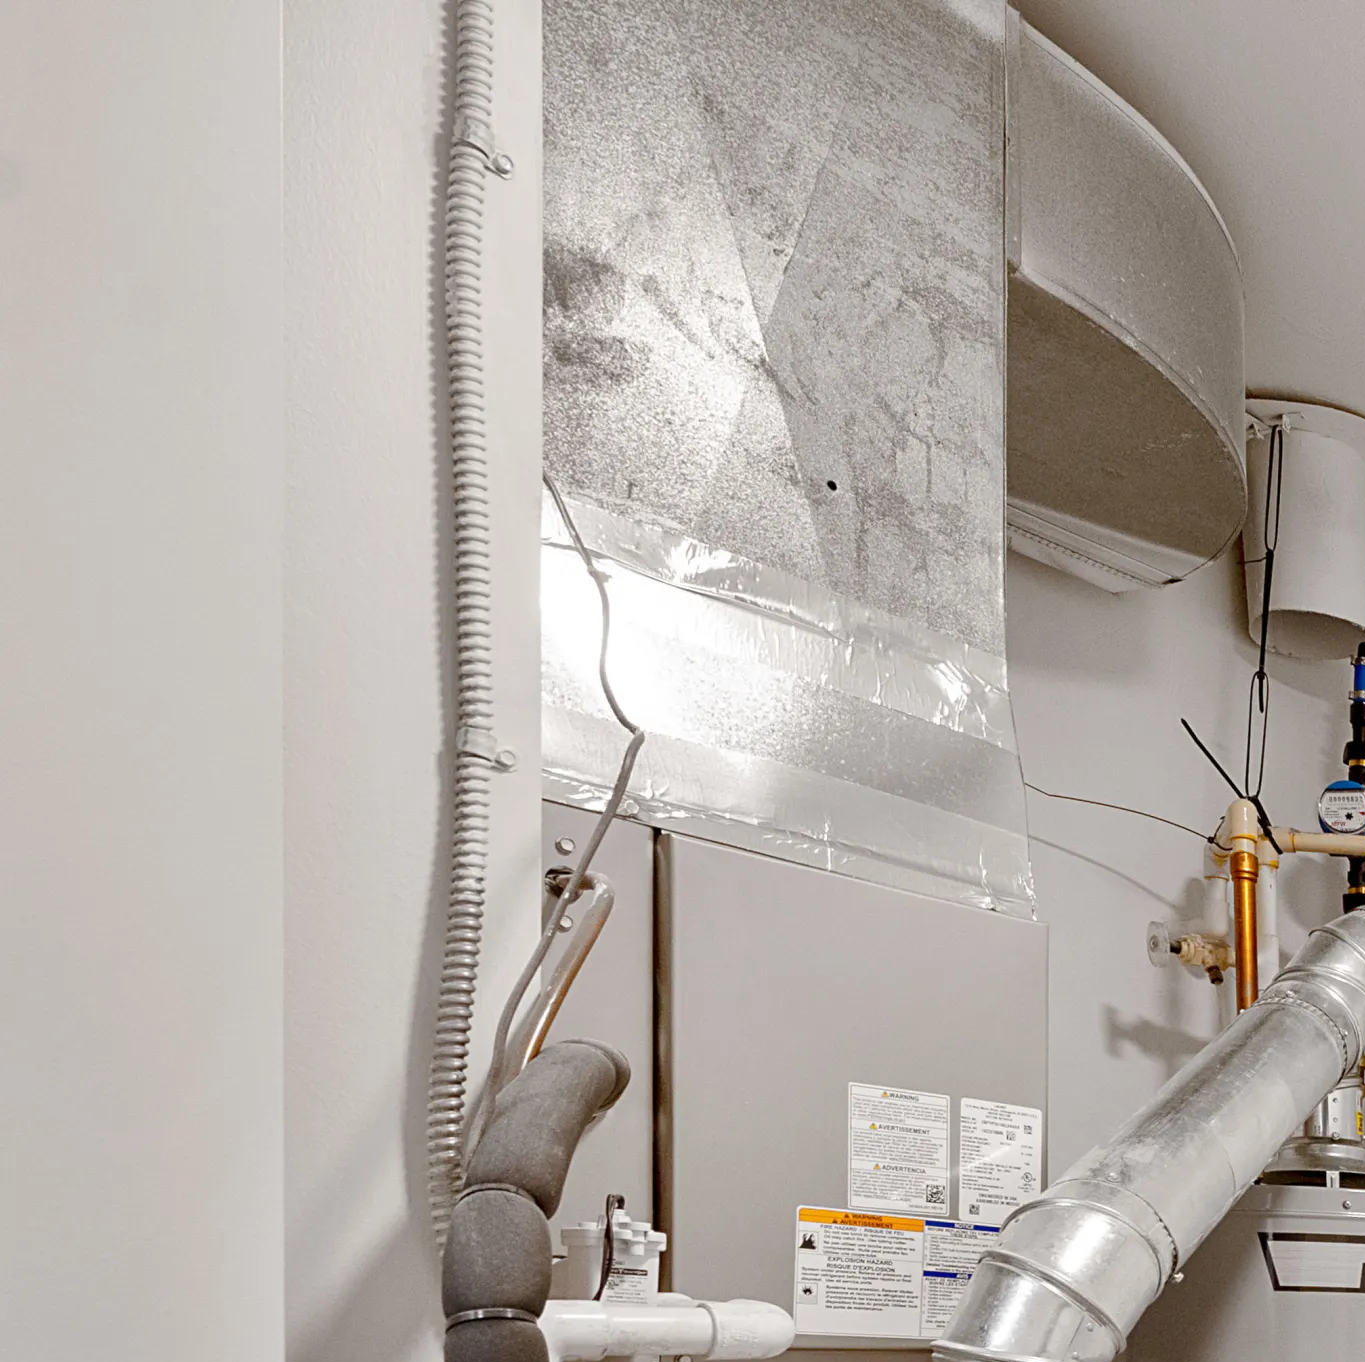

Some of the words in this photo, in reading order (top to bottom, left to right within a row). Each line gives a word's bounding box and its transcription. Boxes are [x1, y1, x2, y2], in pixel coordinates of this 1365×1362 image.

[889, 1093, 919, 1102] WARNING
[878, 1124, 930, 1135] AVERTISSEMENT
[882, 1164, 926, 1174] ADVERTENCIA
[851, 1213, 883, 1222] WARNING
[840, 1219, 894, 1229] AVERTISSEMENT
[827, 1256, 865, 1264] EXPLOSION
[852, 1264, 896, 1273] D'EXPLOSION
